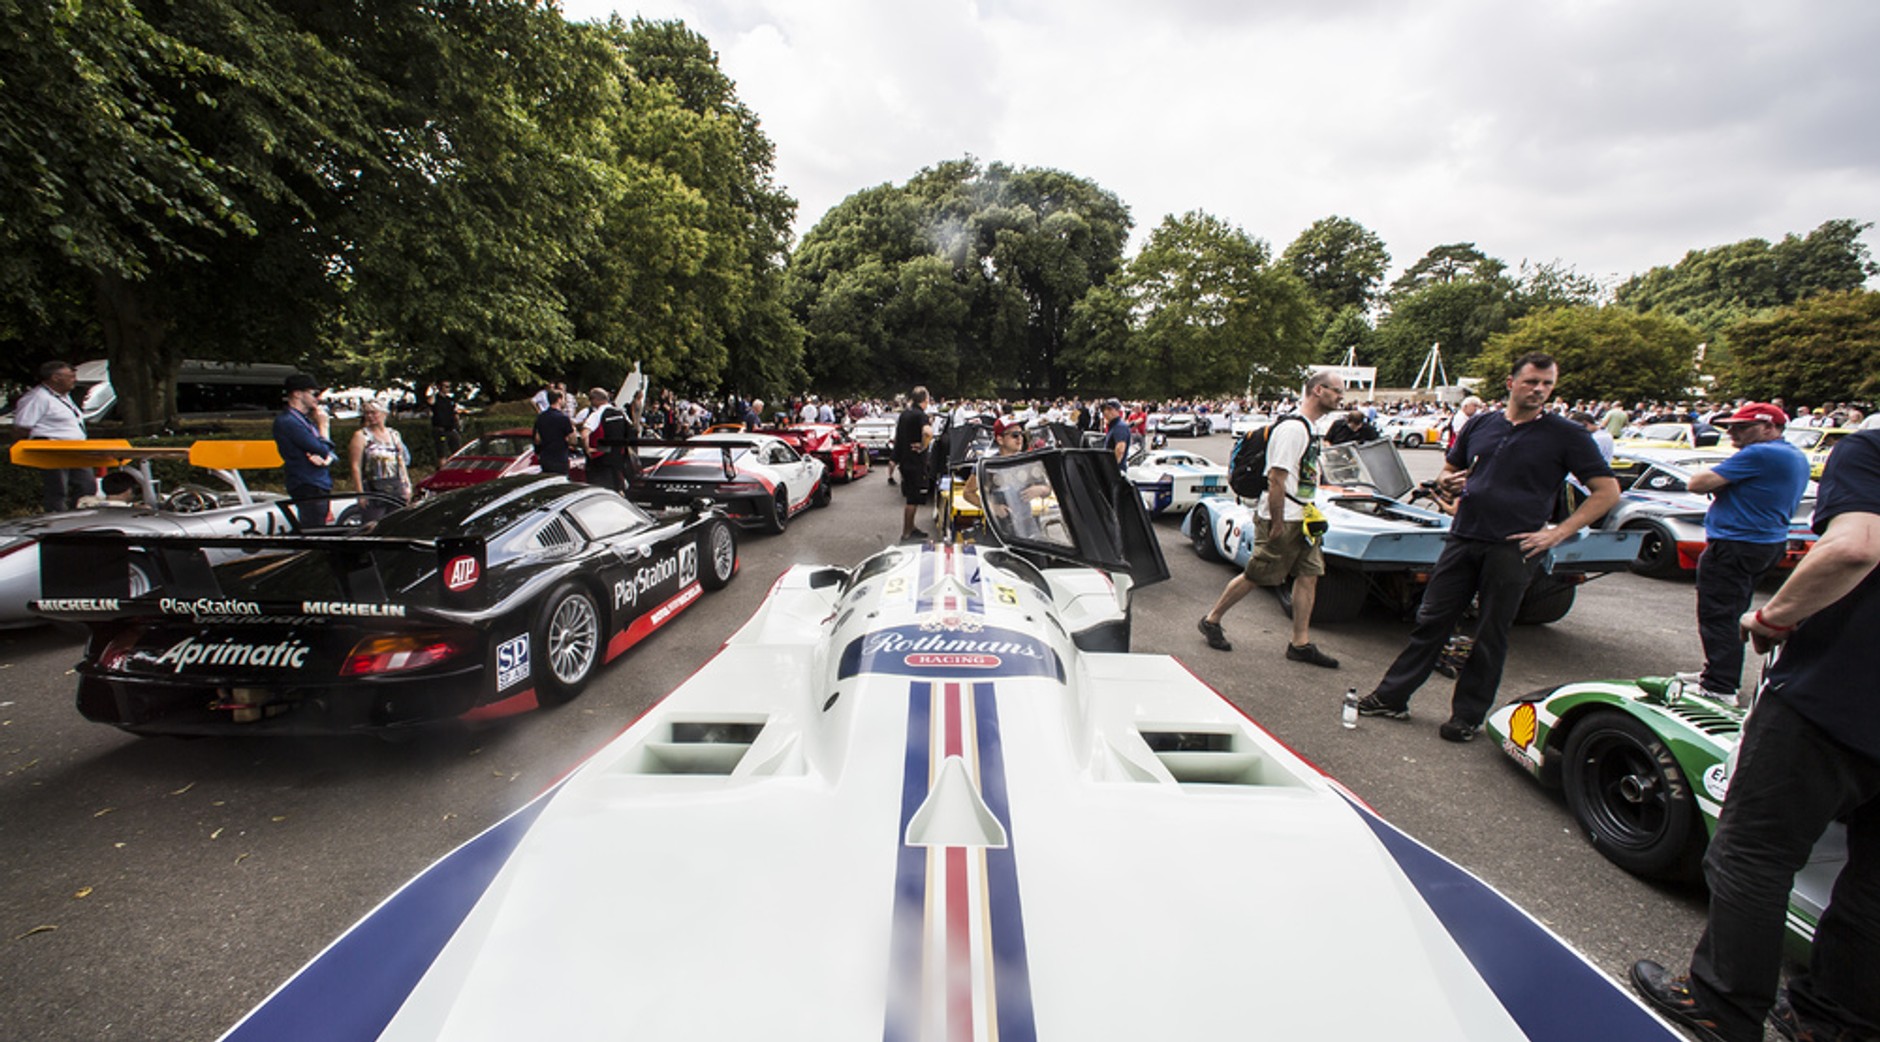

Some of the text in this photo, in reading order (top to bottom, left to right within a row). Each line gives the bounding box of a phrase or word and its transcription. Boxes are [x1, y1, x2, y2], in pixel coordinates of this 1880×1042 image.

[451, 558, 475, 585] ATP
[614, 556, 677, 610] PlayStation
[37, 598, 120, 611] MICHELIN
[160, 598, 261, 617] PlayStation
[302, 601, 405, 617] MICHELIN
[156, 636, 310, 673] Aprimatic
[499, 639, 527, 673] SP
[862, 631, 1044, 660] Rothmans
[919, 655, 985, 665] RACING
